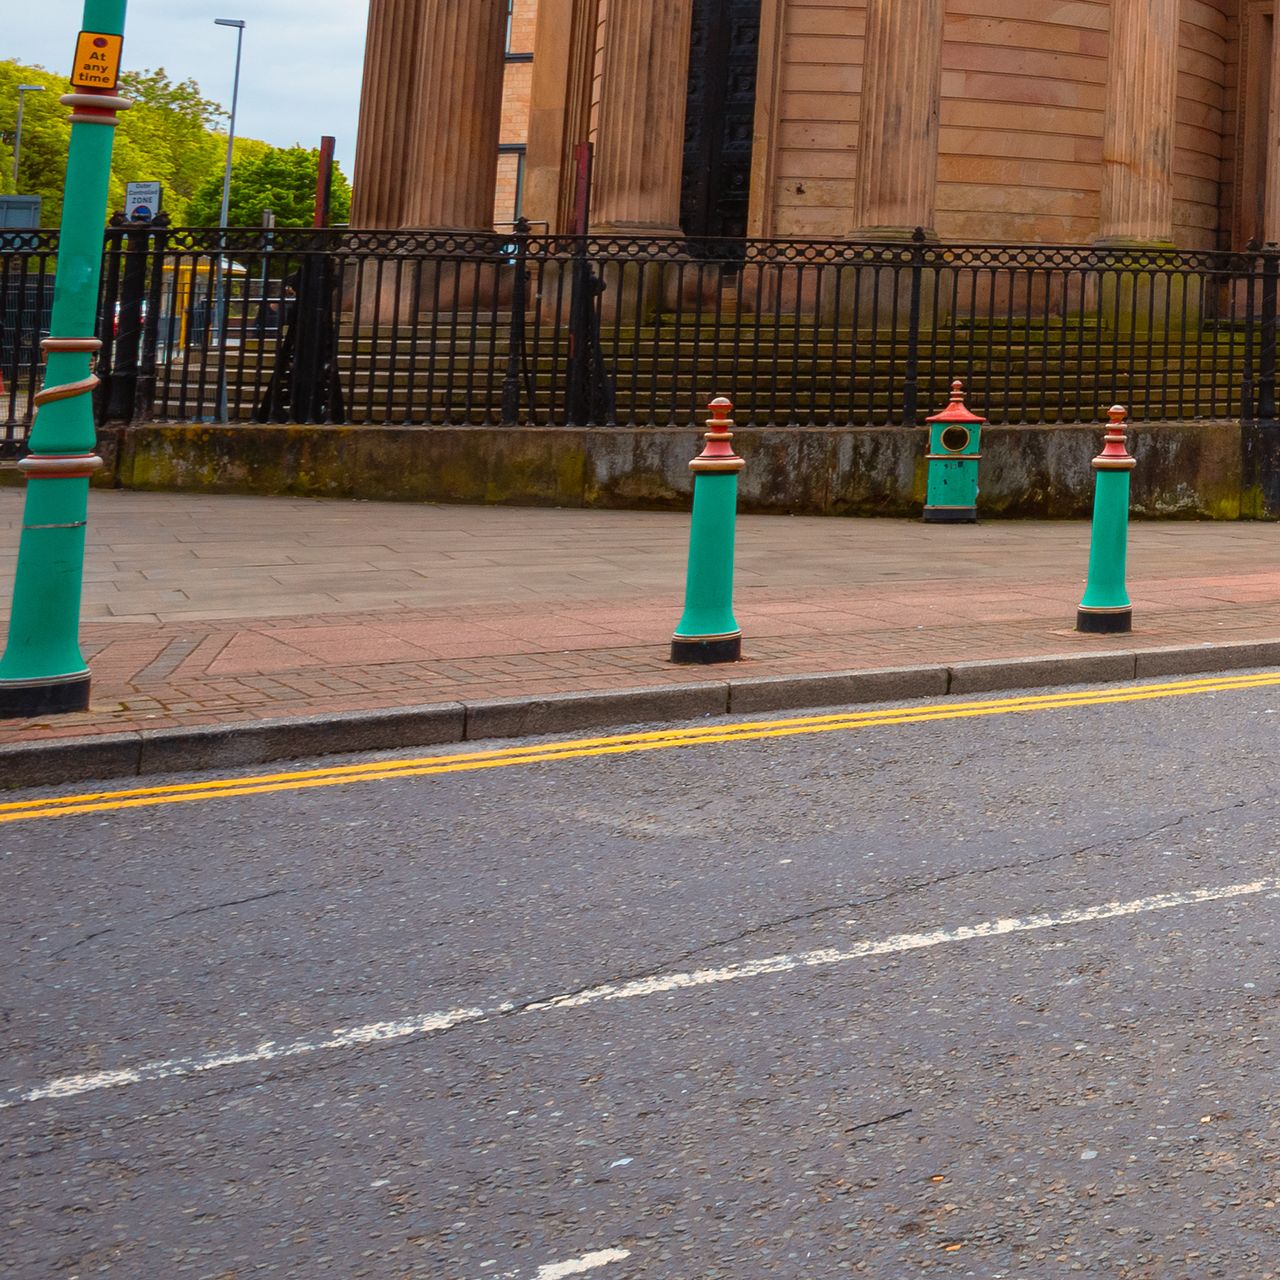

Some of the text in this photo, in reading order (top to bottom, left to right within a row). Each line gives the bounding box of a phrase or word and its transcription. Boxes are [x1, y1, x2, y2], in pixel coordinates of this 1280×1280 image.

[89, 51, 106, 61] At
[83, 63, 108, 73] any
[79, 72, 110, 83] time
[132, 196, 152, 204] ZONE
